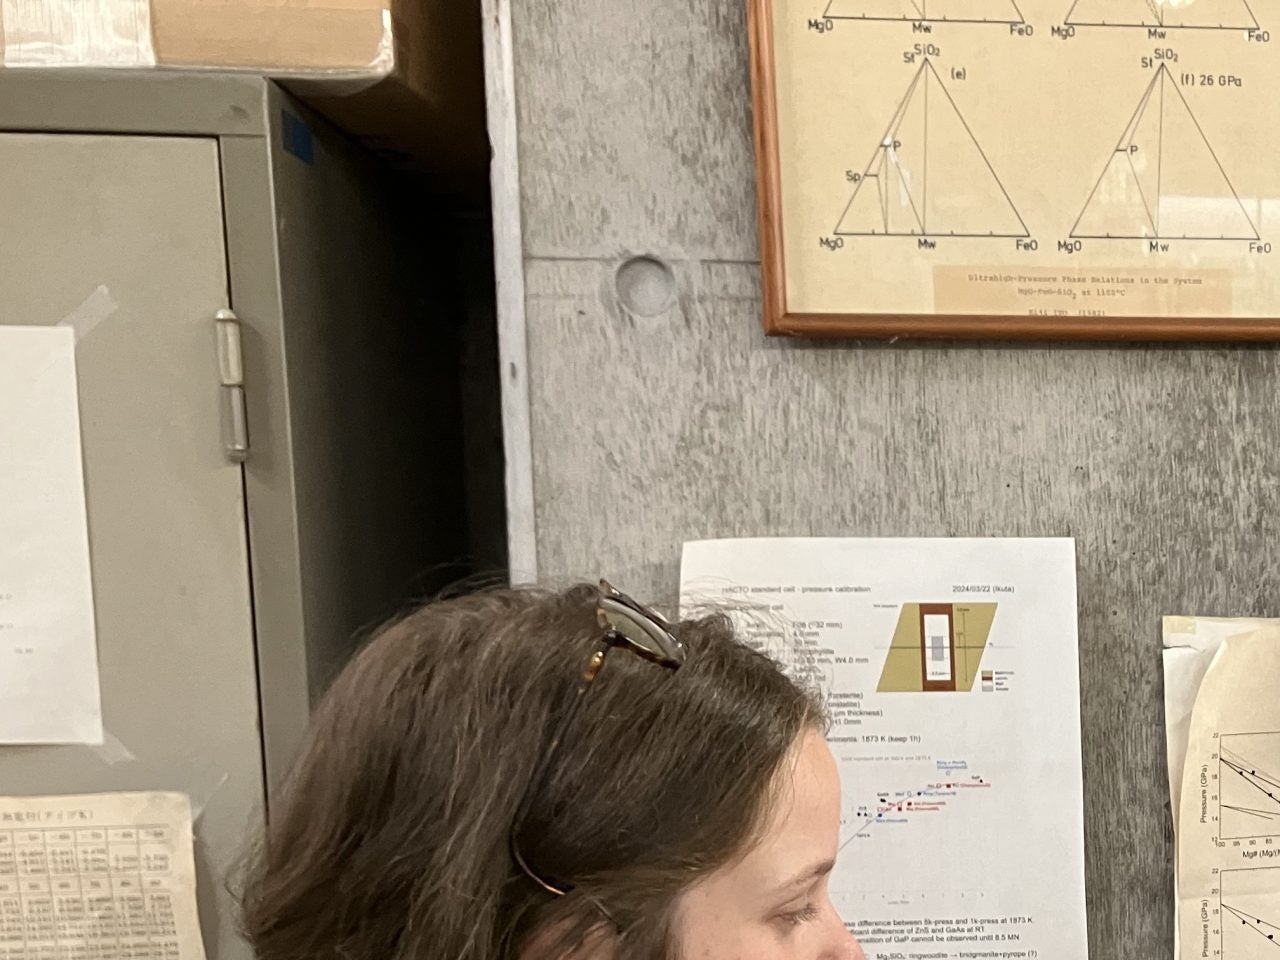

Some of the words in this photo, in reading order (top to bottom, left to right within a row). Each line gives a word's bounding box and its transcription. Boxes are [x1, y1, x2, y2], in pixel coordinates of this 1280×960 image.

[807, 19, 834, 33] MgO
[912, 22, 932, 34] Mw
[1009, 24, 1034, 36] FeO
[1051, 26, 1075, 40] MgO
[1148, 29, 1167, 40] Mw
[1247, 30, 1270, 42] FeO
[1141, 57, 1153, 68] St
[951, 67, 967, 80] (e)
[1180, 73, 1195, 86] (f)
[1199, 74, 1214, 86] 26
[1218, 74, 1242, 87] GPa
[893, 140, 902, 151] P
[1130, 145, 1139, 155] P
[845, 170, 861, 184] Sp
[819, 238, 844, 250] MgO
[918, 239, 936, 249] Mw
[1016, 239, 1038, 250] FeO
[1057, 240, 1082, 254] MgO
[1149, 241, 1169, 253] Mw
[1249, 242, 1272, 253] FeO
[1140, 276, 1150, 284] in
[1154, 276, 1169, 285] the
[751, 585, 781, 593] standard
[783, 585, 796, 593] cell
[801, 586, 833, 594] pressure
[835, 585, 871, 593] calibration
[952, 585, 991, 593] 2024/03/22
[847, 709, 883, 717] thickness)
[887, 736, 909, 744] (keep
[1200, 764, 1208, 789] (GPa)
[1200, 790, 1208, 824] Pressure
[857, 919, 892, 927] difference
[893, 919, 922, 927] between
[955, 917, 968, 925] and
[1009, 916, 1026, 924] 1873
[871, 927, 905, 935] difference
